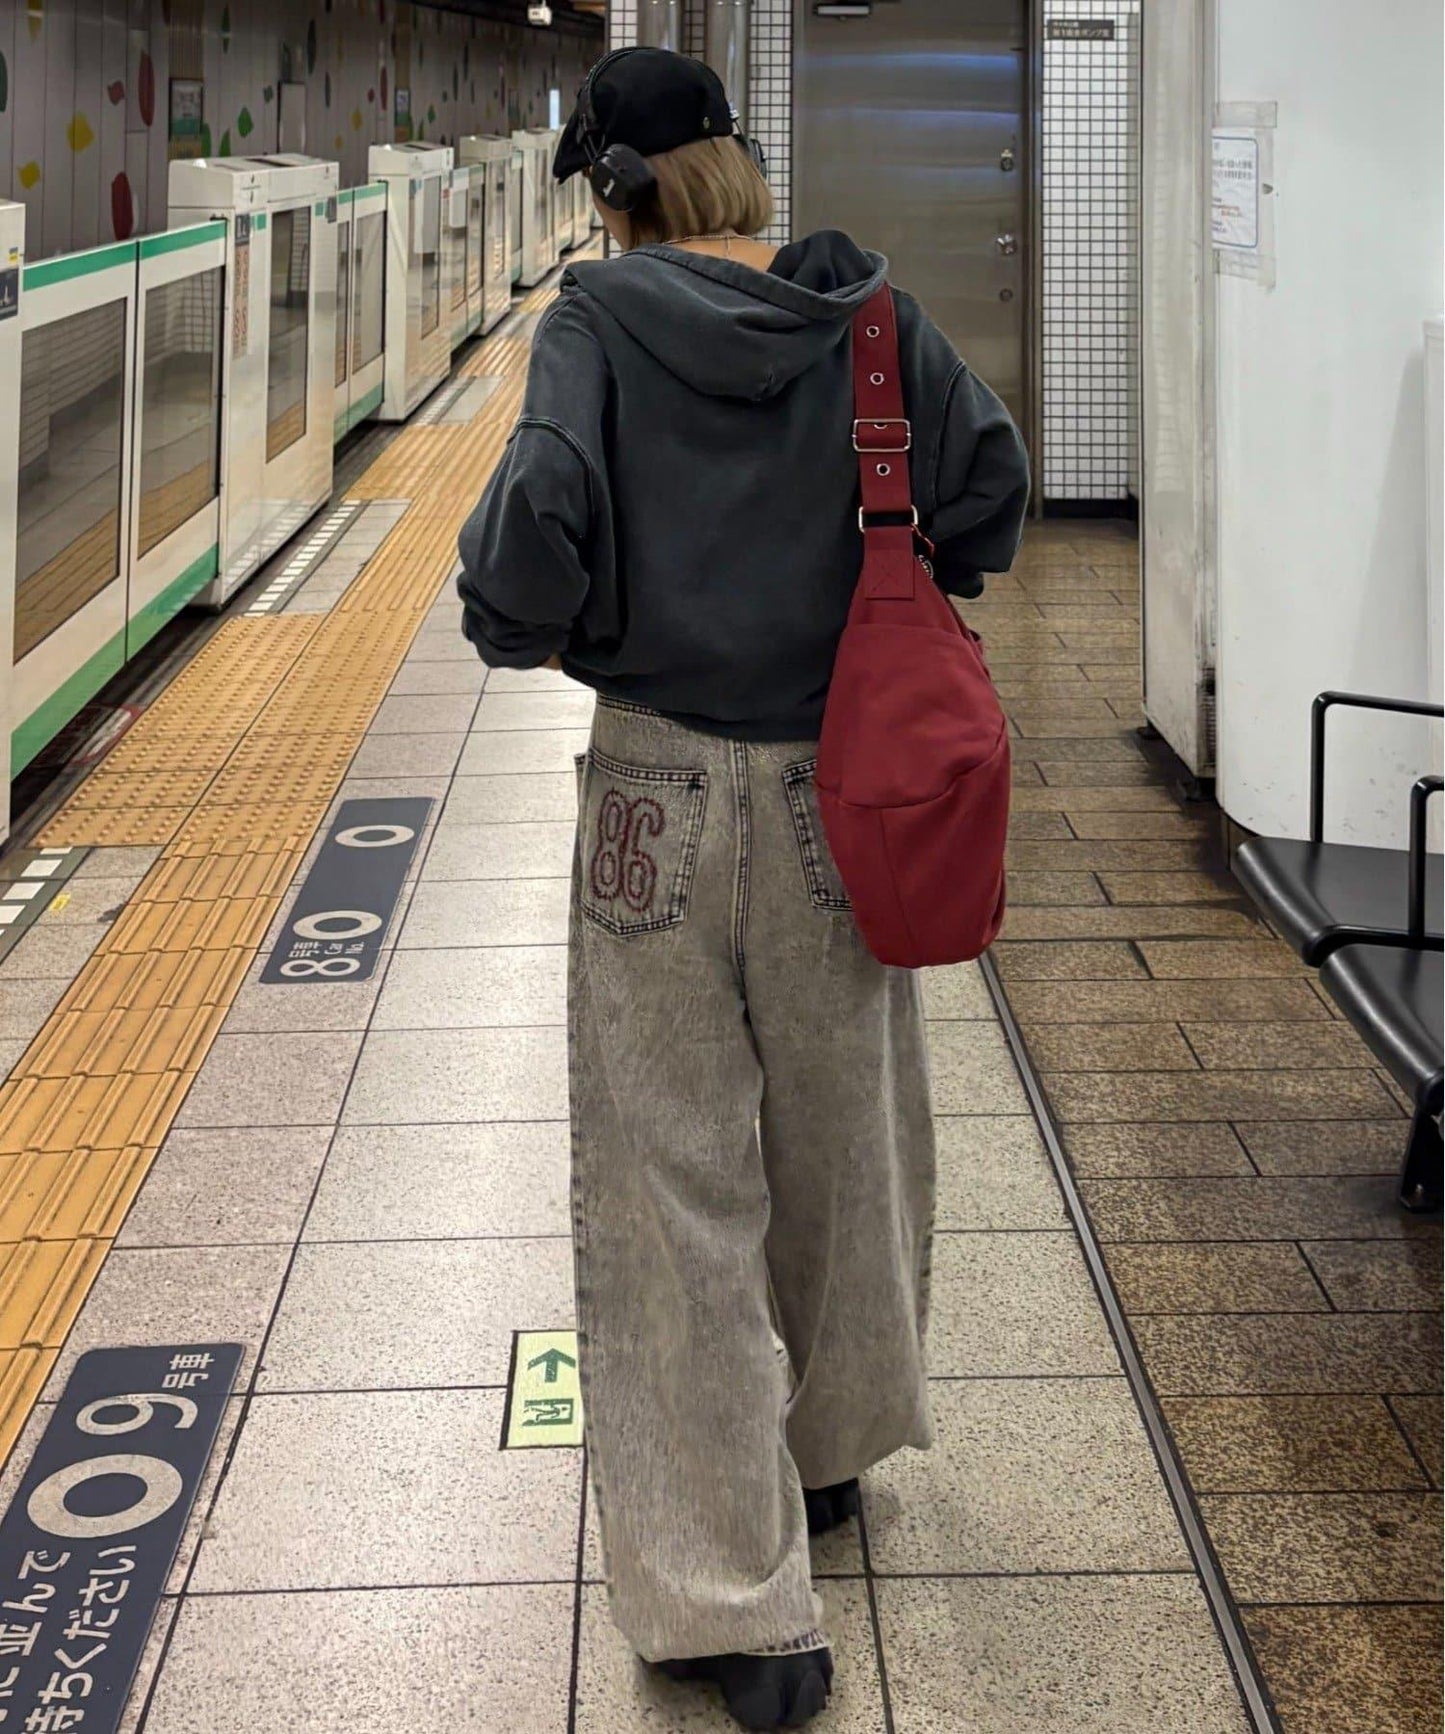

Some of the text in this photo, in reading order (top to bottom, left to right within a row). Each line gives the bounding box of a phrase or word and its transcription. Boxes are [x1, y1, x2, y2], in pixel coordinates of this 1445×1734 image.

[590, 787, 666, 913] 86
[0, 1550, 71, 1722] 並んで
